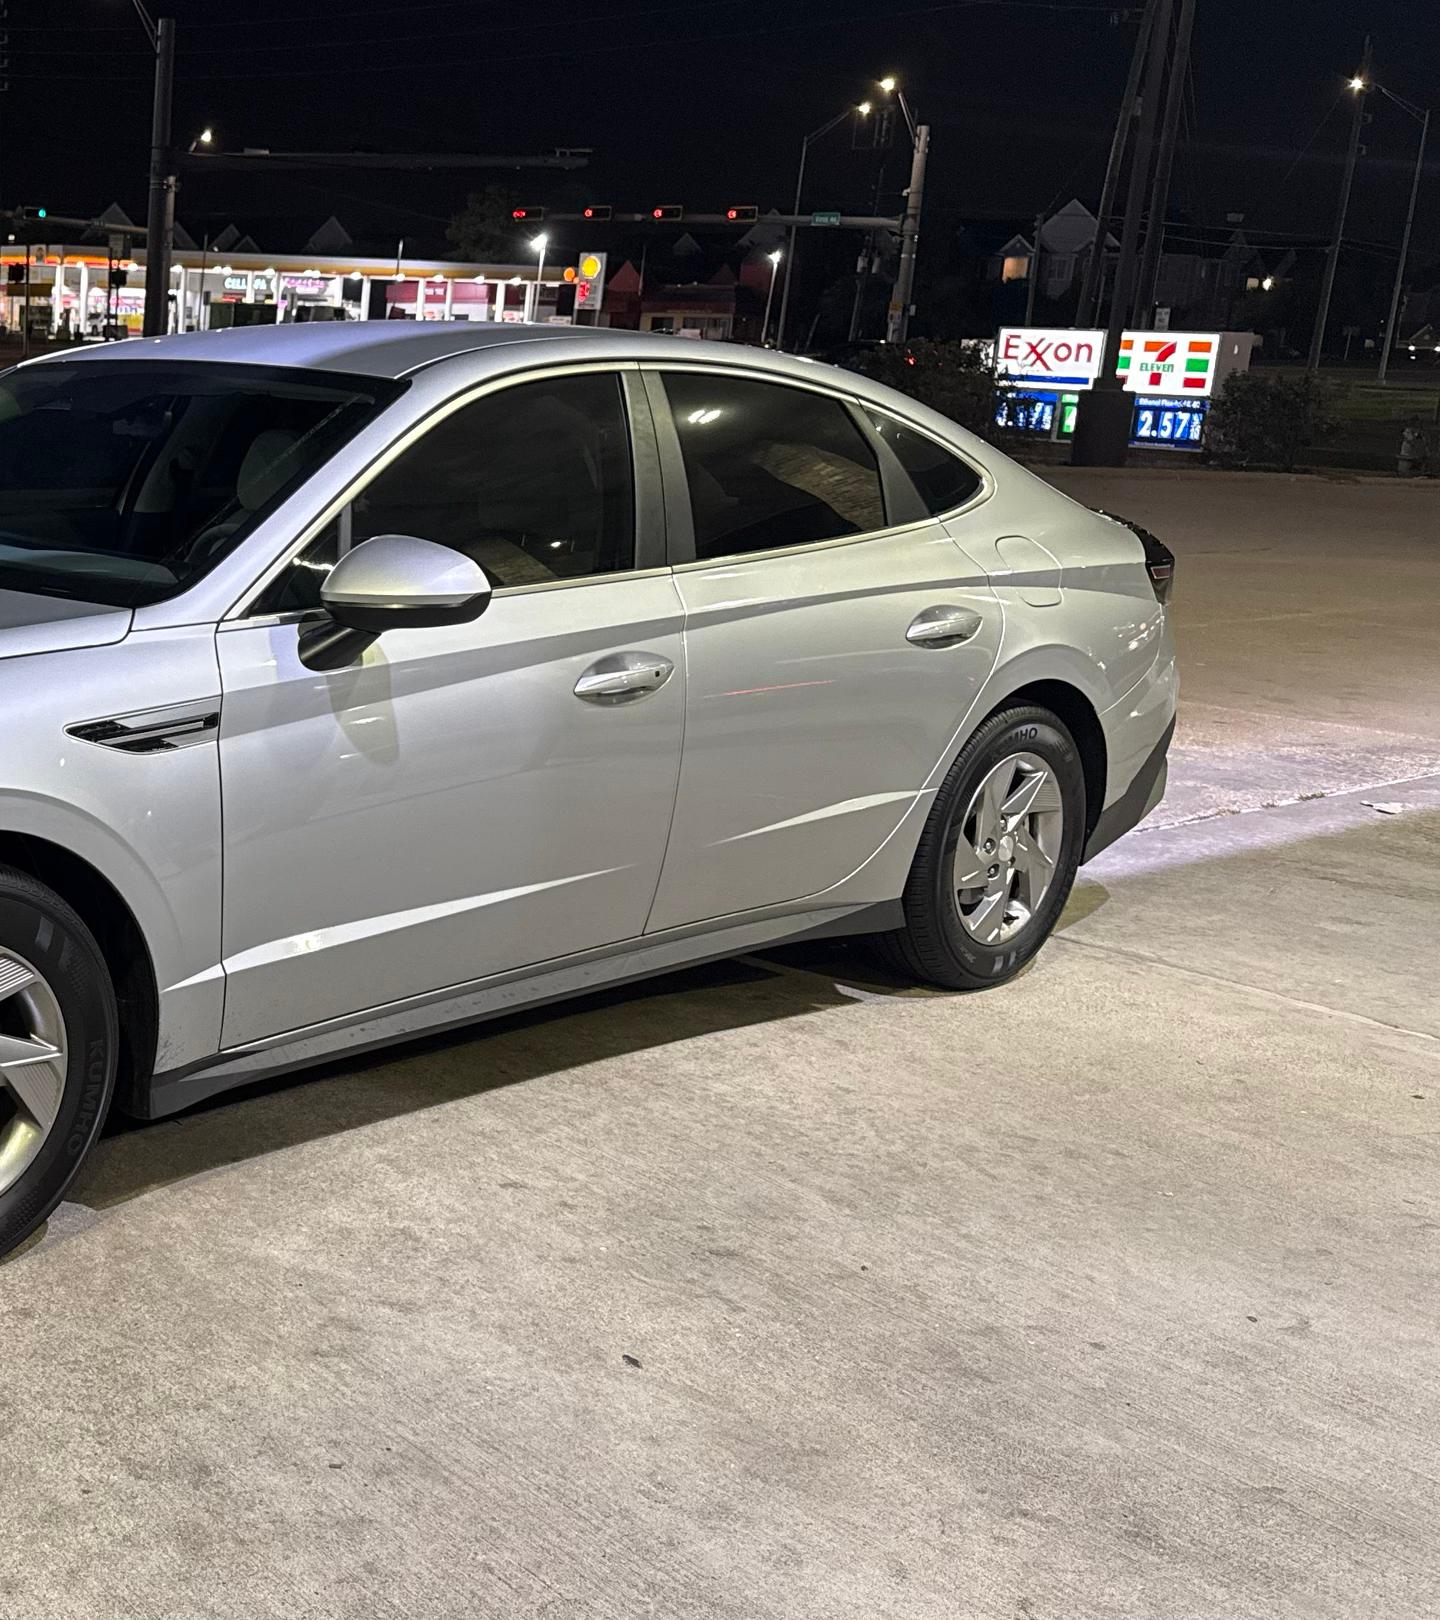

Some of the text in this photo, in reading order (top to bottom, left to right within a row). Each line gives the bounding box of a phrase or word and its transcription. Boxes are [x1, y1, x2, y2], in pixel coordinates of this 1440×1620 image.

[1003, 334, 1093, 371] Exxon
[1143, 340, 1178, 386] 7
[65, 1039, 106, 1155] KUMHO
